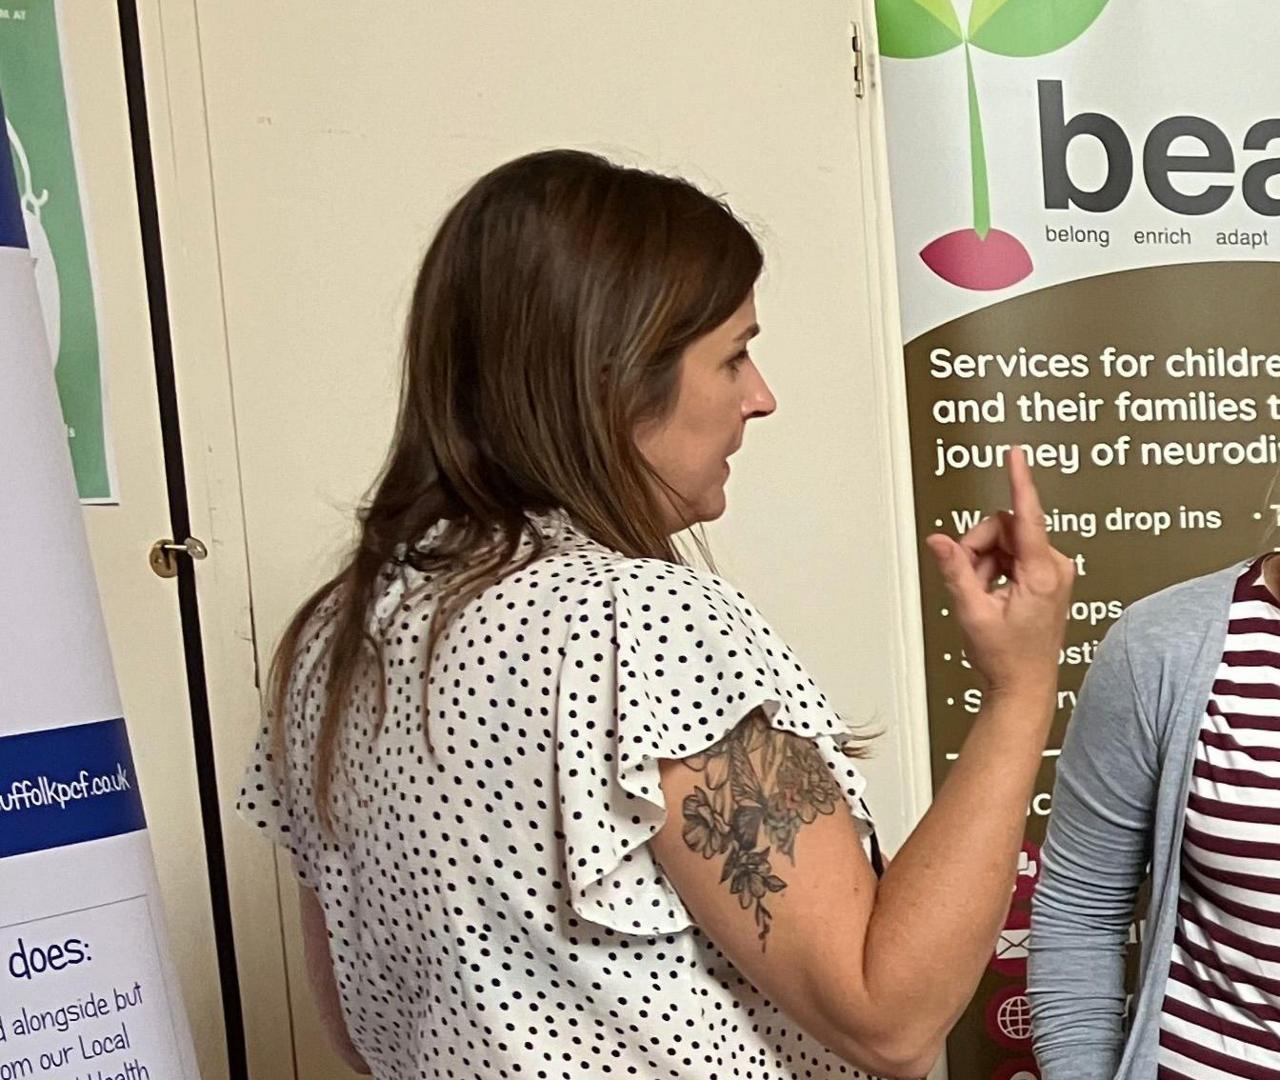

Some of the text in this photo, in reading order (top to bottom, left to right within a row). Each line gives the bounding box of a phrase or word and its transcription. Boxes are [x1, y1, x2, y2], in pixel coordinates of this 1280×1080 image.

[1046, 225, 1109, 247] belong
[1134, 228, 1191, 244] enrich
[1216, 229, 1268, 249] adapt
[930, 347, 1089, 378] Services
[1100, 347, 1154, 377] for
[933, 393, 1005, 423] and
[1017, 392, 1104, 422] their
[1115, 391, 1256, 421] families
[934, 440, 1080, 477] journey
[1091, 437, 1130, 466] of
[1106, 507, 1170, 535] drop
[1180, 506, 1221, 528] ins
[9, 938, 91, 979] does:
[13, 982, 142, 1035] alongside but
